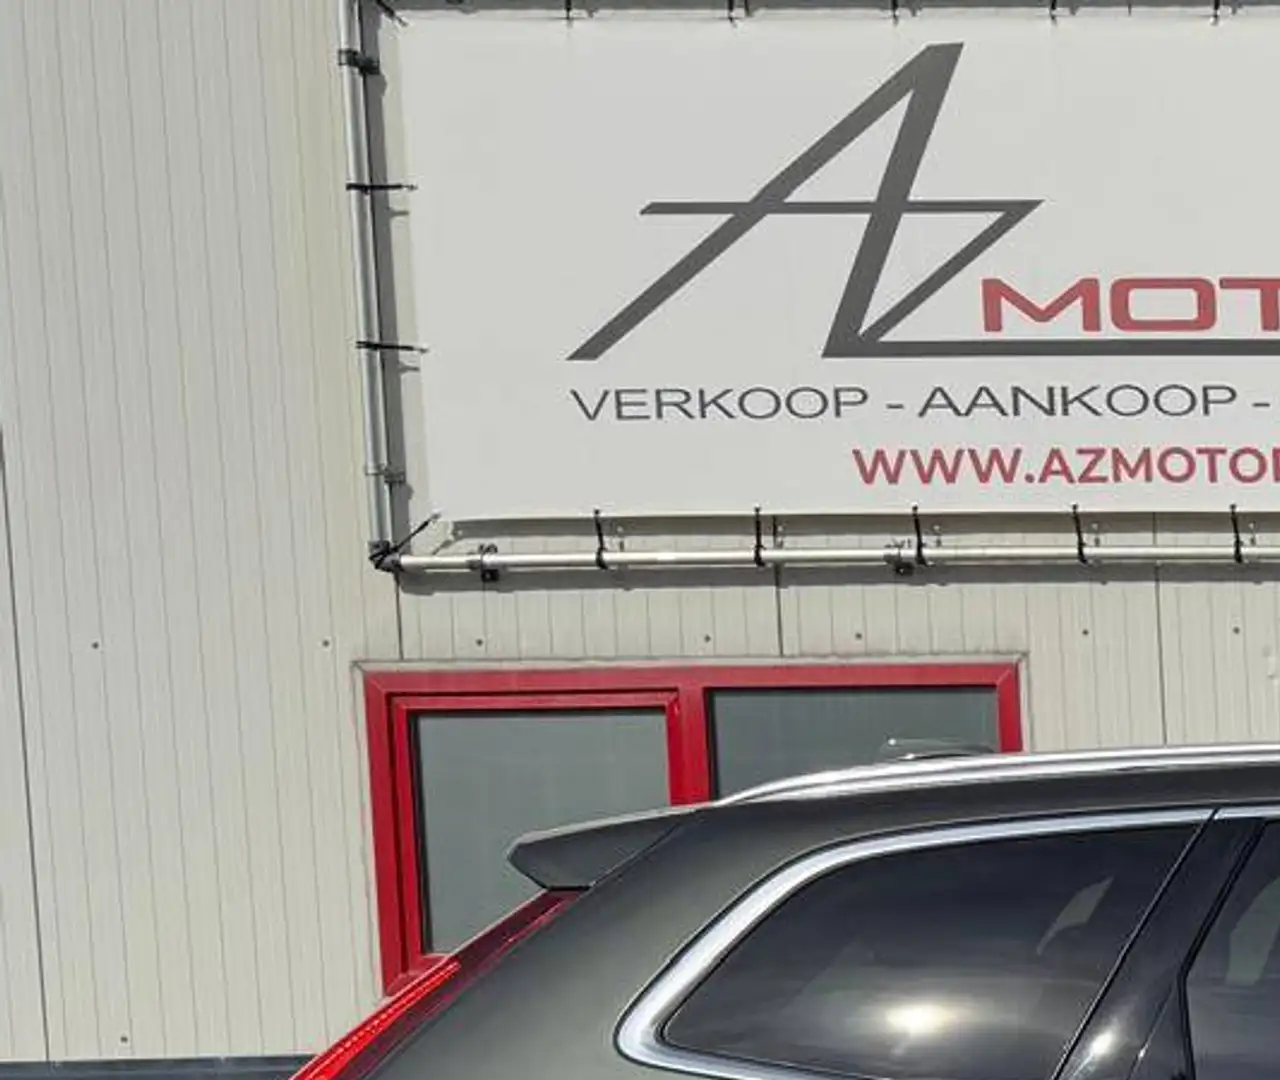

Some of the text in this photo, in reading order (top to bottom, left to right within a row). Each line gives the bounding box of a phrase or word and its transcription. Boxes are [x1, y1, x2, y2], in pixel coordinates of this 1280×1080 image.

[567, 43, 1043, 360] AZ
[570, 386, 869, 421] VERKOOP
[918, 384, 1237, 418] AANKOOP
